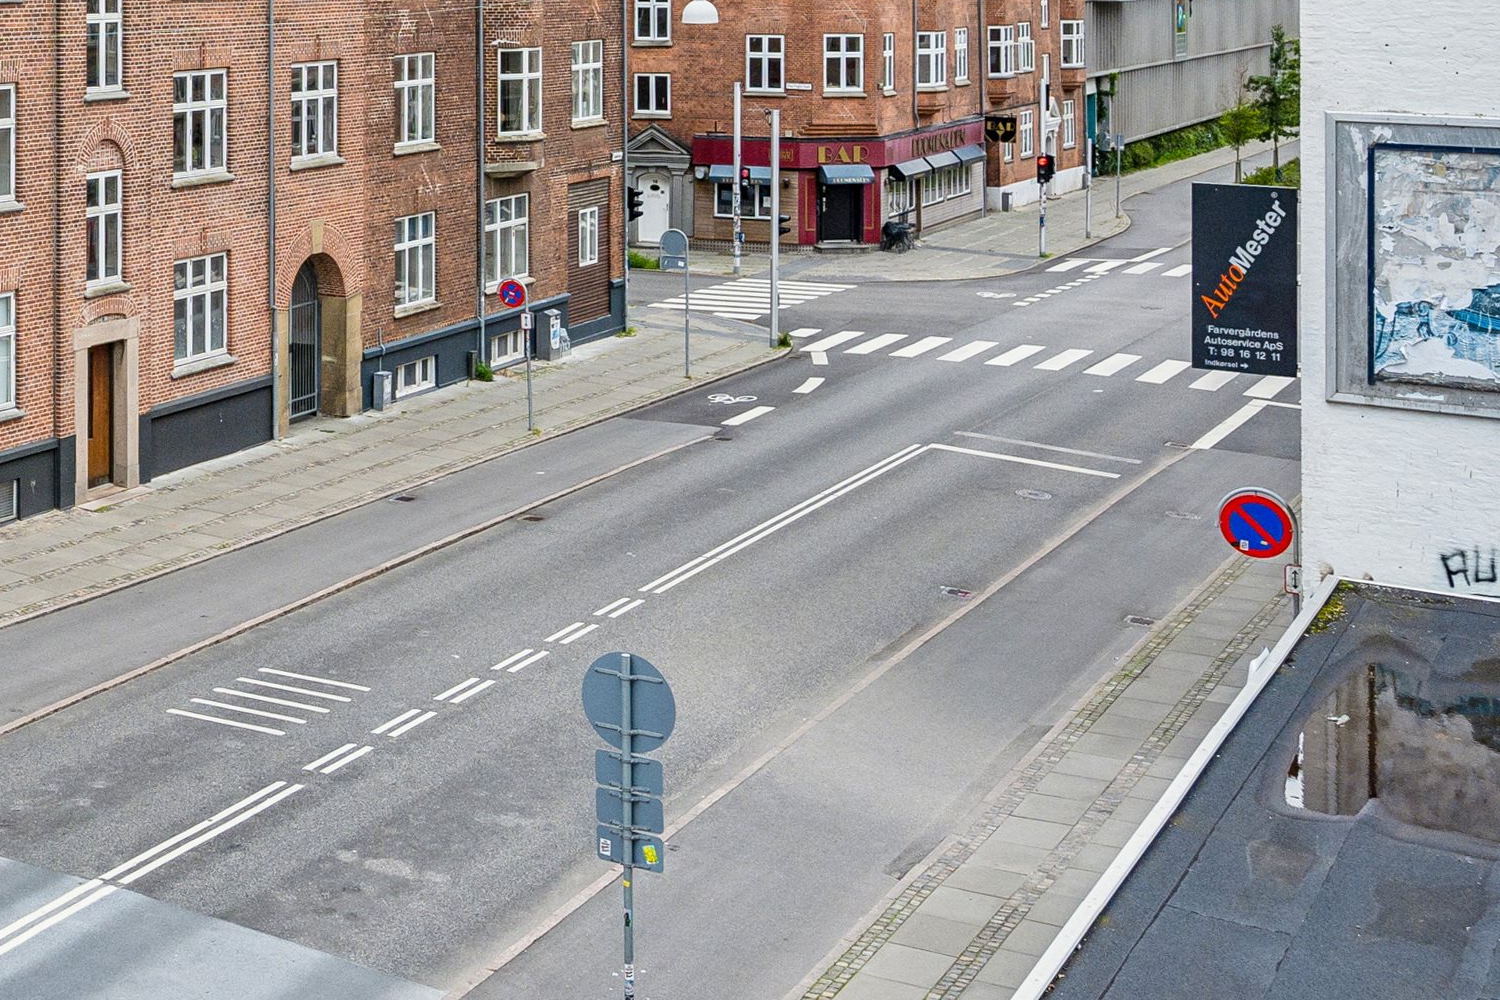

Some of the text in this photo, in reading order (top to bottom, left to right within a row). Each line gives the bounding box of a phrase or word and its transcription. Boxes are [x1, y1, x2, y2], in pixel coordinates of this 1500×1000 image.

[985, 120, 1015, 132] BAR
[817, 144, 870, 164] BAR
[1201, 199, 1287, 319] AutoMester
[1207, 324, 1279, 340] Farvergårdens
[1203, 335, 1284, 351] Autoservice ApS
[1208, 346, 1281, 361] T: 98 16 12 11
[1204, 358, 1238, 368] Indkørsel
